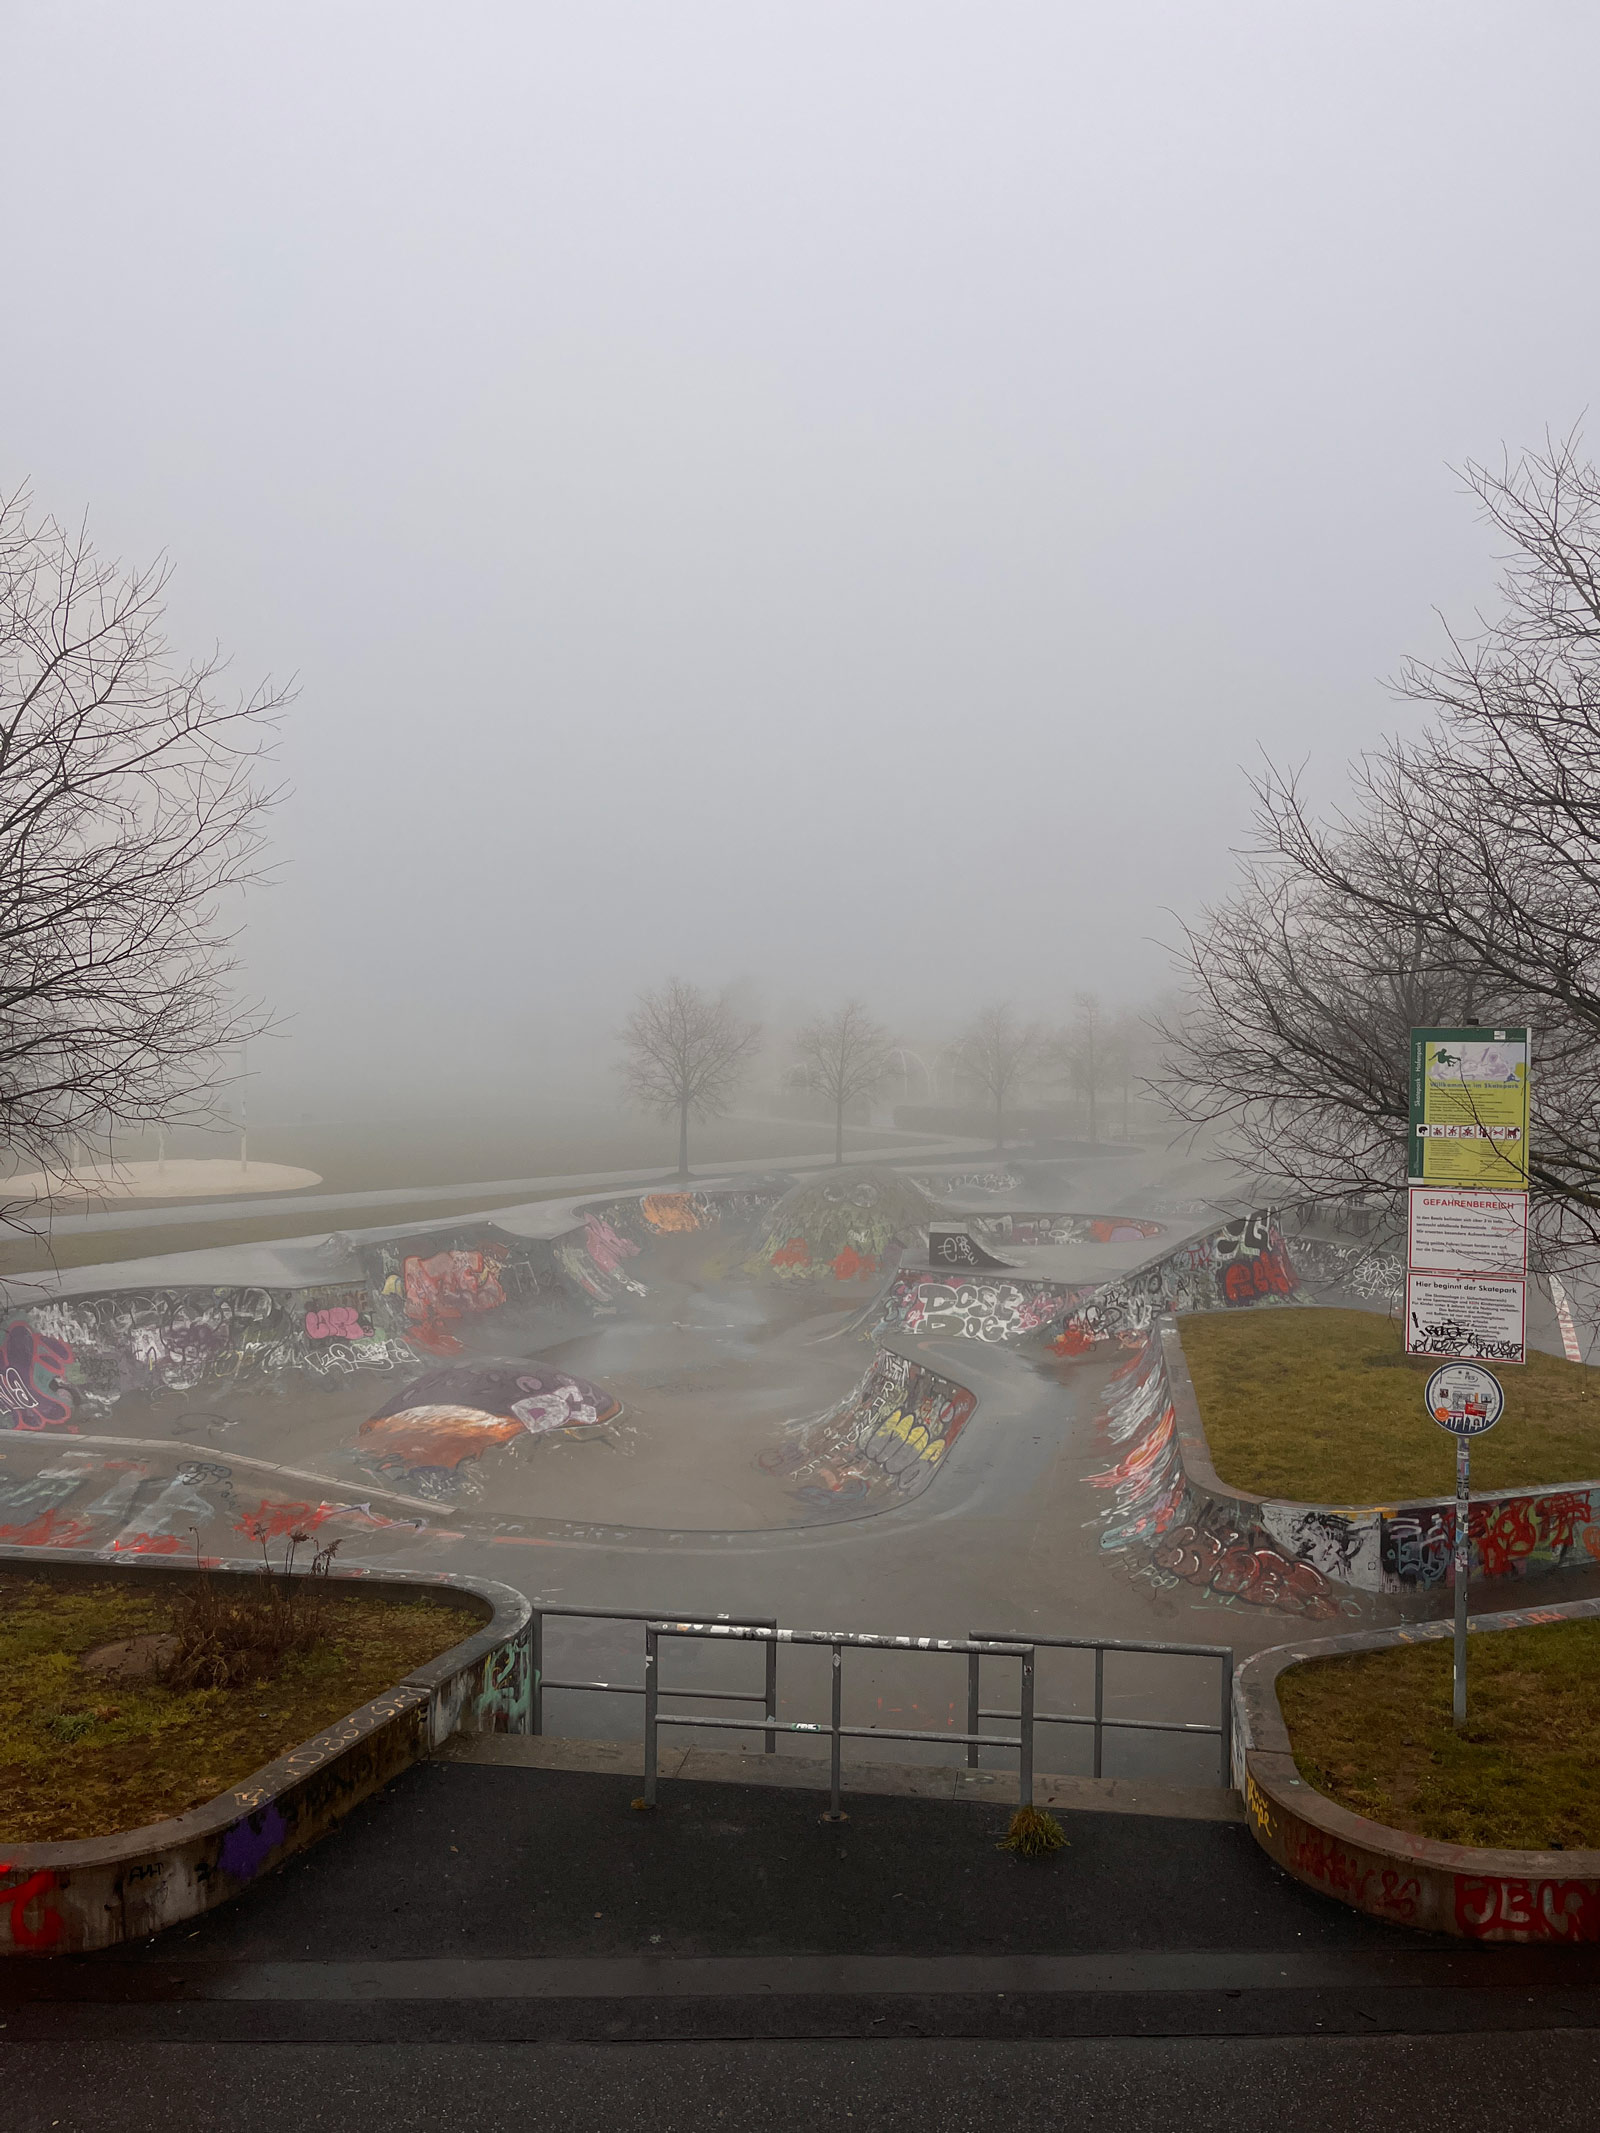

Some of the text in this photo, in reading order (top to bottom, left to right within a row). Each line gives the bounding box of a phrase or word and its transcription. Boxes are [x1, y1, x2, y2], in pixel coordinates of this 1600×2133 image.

[1414, 1078, 1422, 1107] Skatepark
[1423, 1198, 1514, 1209] GEFAHRENBEREICH
[1433, 1282, 1462, 1290] beginnt
[1479, 1285, 1517, 1294] Skatepark
